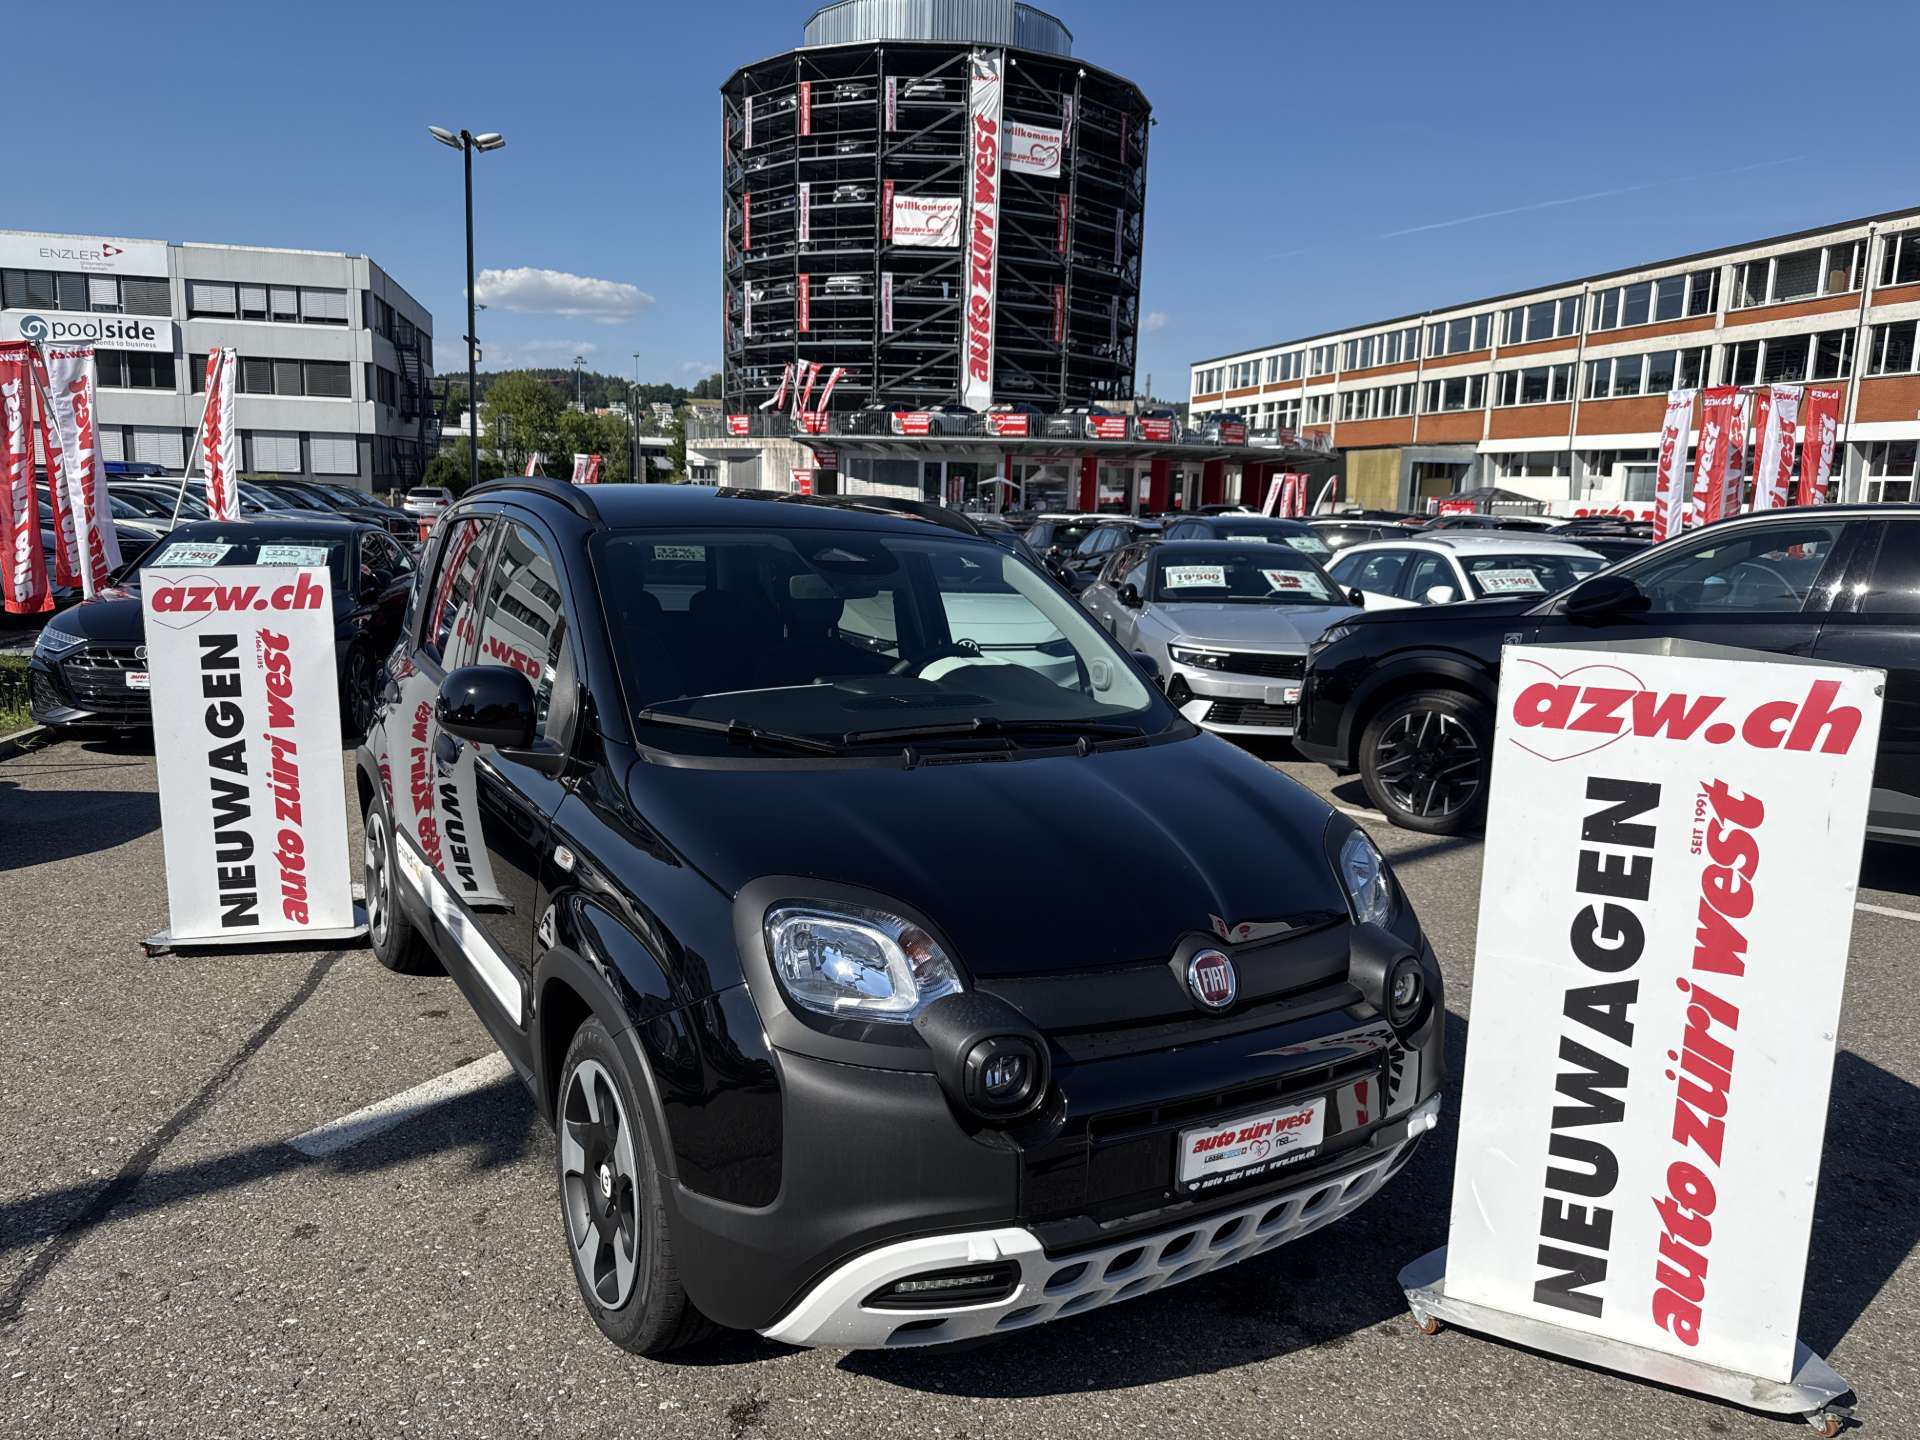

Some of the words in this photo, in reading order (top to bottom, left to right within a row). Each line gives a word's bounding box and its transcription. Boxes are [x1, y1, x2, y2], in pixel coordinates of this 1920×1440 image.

[976, 113, 998, 204] west
[1004, 127, 1060, 143] willkommen
[39, 248, 100, 260] ENZLER
[970, 209, 994, 293] züri
[52, 318, 155, 340] poolside
[968, 295, 990, 383] auto
[151, 573, 324, 613] azw.ch
[169, 551, 218, 560] 31'950
[261, 627, 295, 728] west
[1512, 679, 1865, 756] azw.ch
[198, 633, 260, 929] NEUWAGEN
[263, 732, 303, 828] züri
[1692, 791, 1710, 826] 1991
[273, 828, 310, 926] auto
[1690, 828, 1703, 857] SEIT
[1692, 777, 1766, 978] west
[1200, 965, 1226, 994] FIAT
[1532, 775, 1662, 1320] NEUWAGEN
[1665, 977, 1740, 1168] züri
[1192, 1129, 1236, 1154] auto
[1236, 1118, 1276, 1144] züri
[1276, 1107, 1314, 1133] west
[1202, 1177, 1222, 1189] auto
[1246, 1164, 1266, 1177] west
[1650, 1160, 1718, 1348] auto
